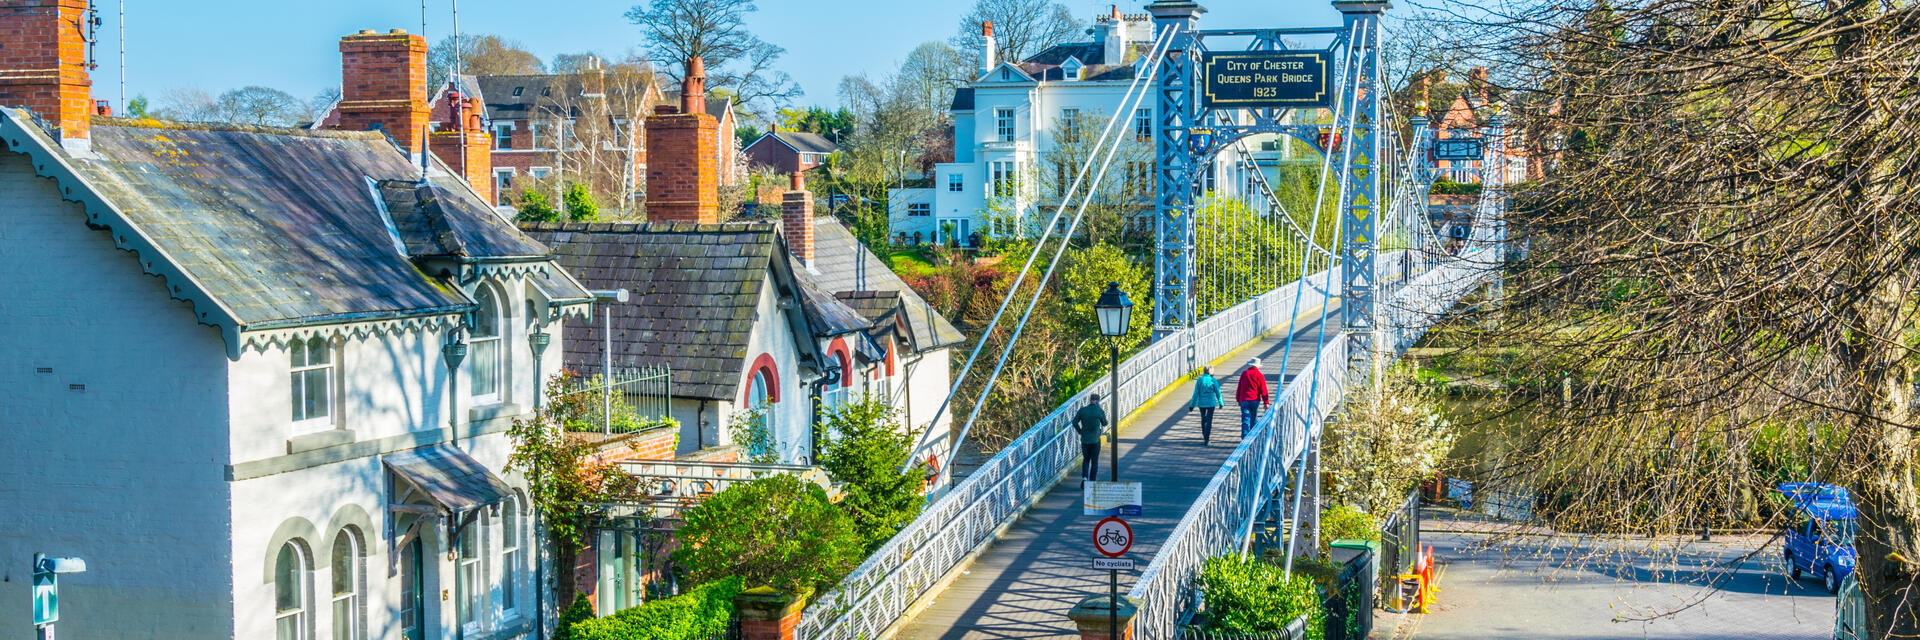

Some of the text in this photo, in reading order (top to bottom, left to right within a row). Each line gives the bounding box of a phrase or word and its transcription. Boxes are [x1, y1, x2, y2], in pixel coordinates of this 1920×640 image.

[1227, 60, 1304, 71] CITY OF CHESTER
[1217, 73, 1313, 84] QUEENS PARK BRIDGE
[1253, 87, 1277, 97] 1923
[1107, 560, 1132, 569] cyclists
